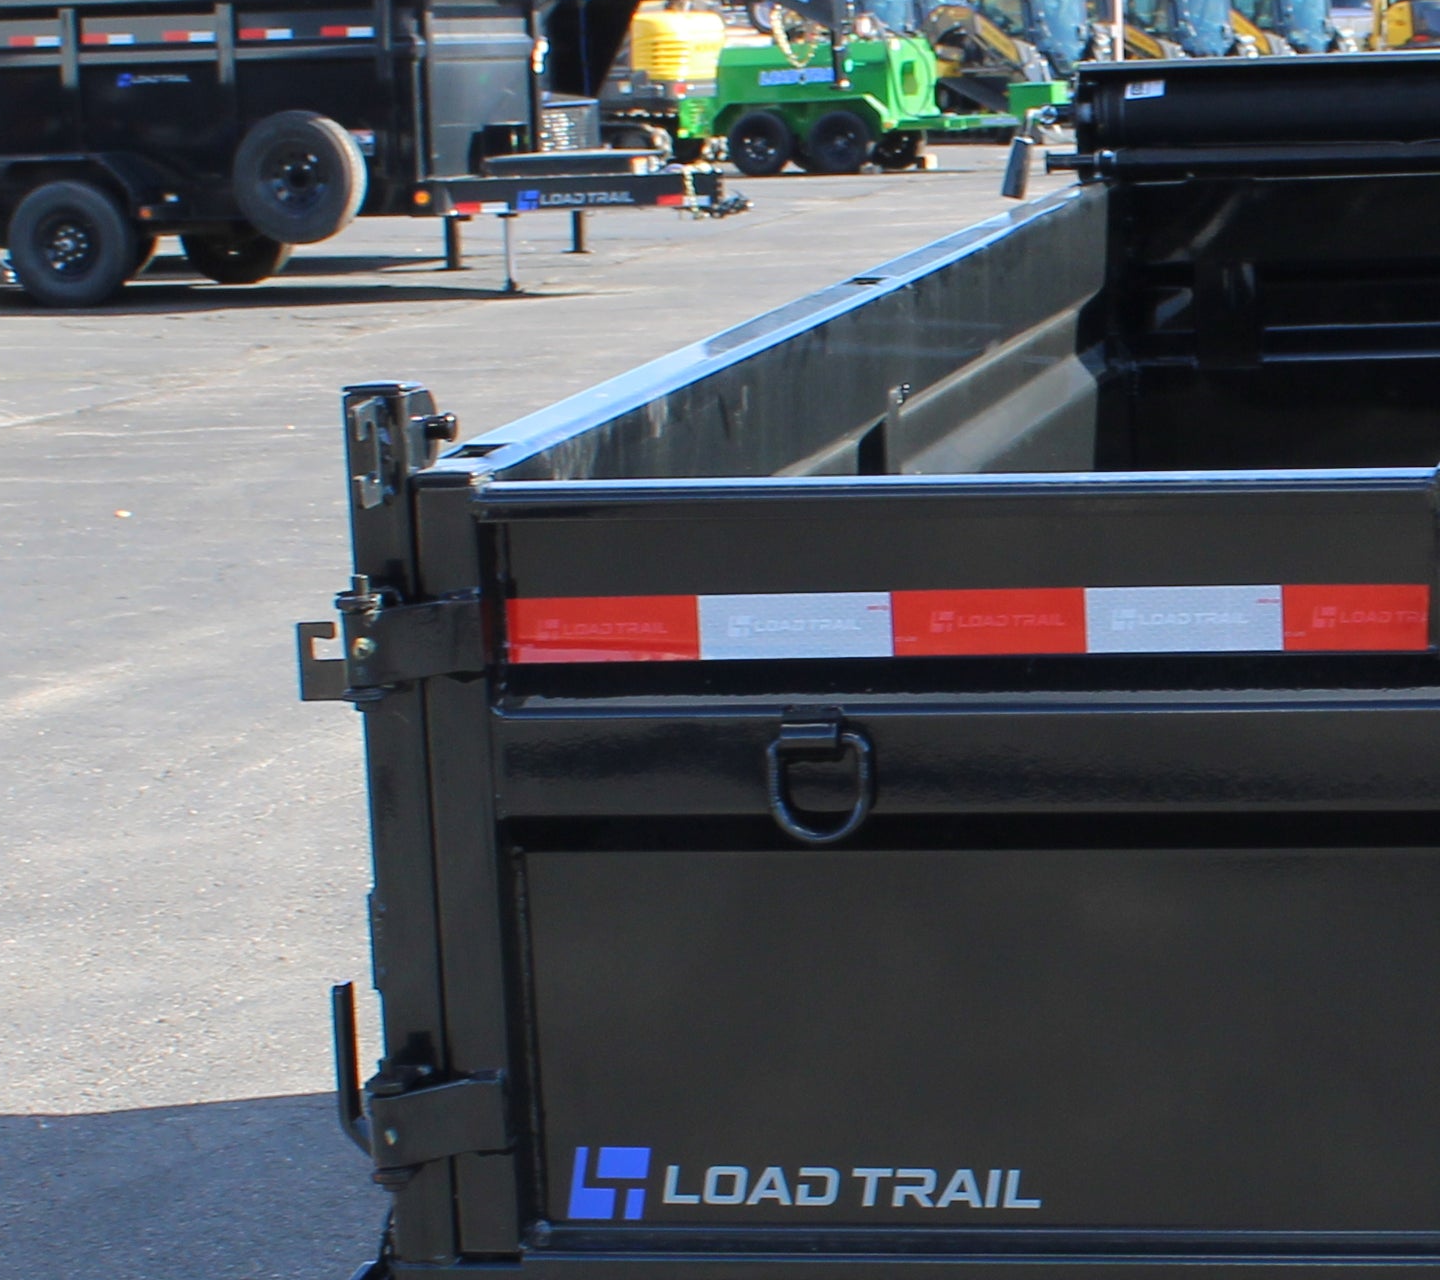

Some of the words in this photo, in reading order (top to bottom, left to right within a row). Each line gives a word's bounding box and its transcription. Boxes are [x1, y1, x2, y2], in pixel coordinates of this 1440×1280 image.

[540, 192, 587, 206] LOAD
[587, 191, 635, 204] TRAIL
[1394, 610, 1429, 623] TRA
[662, 1164, 841, 1206] LOAD
[852, 1166, 1042, 1209] TRAIL
